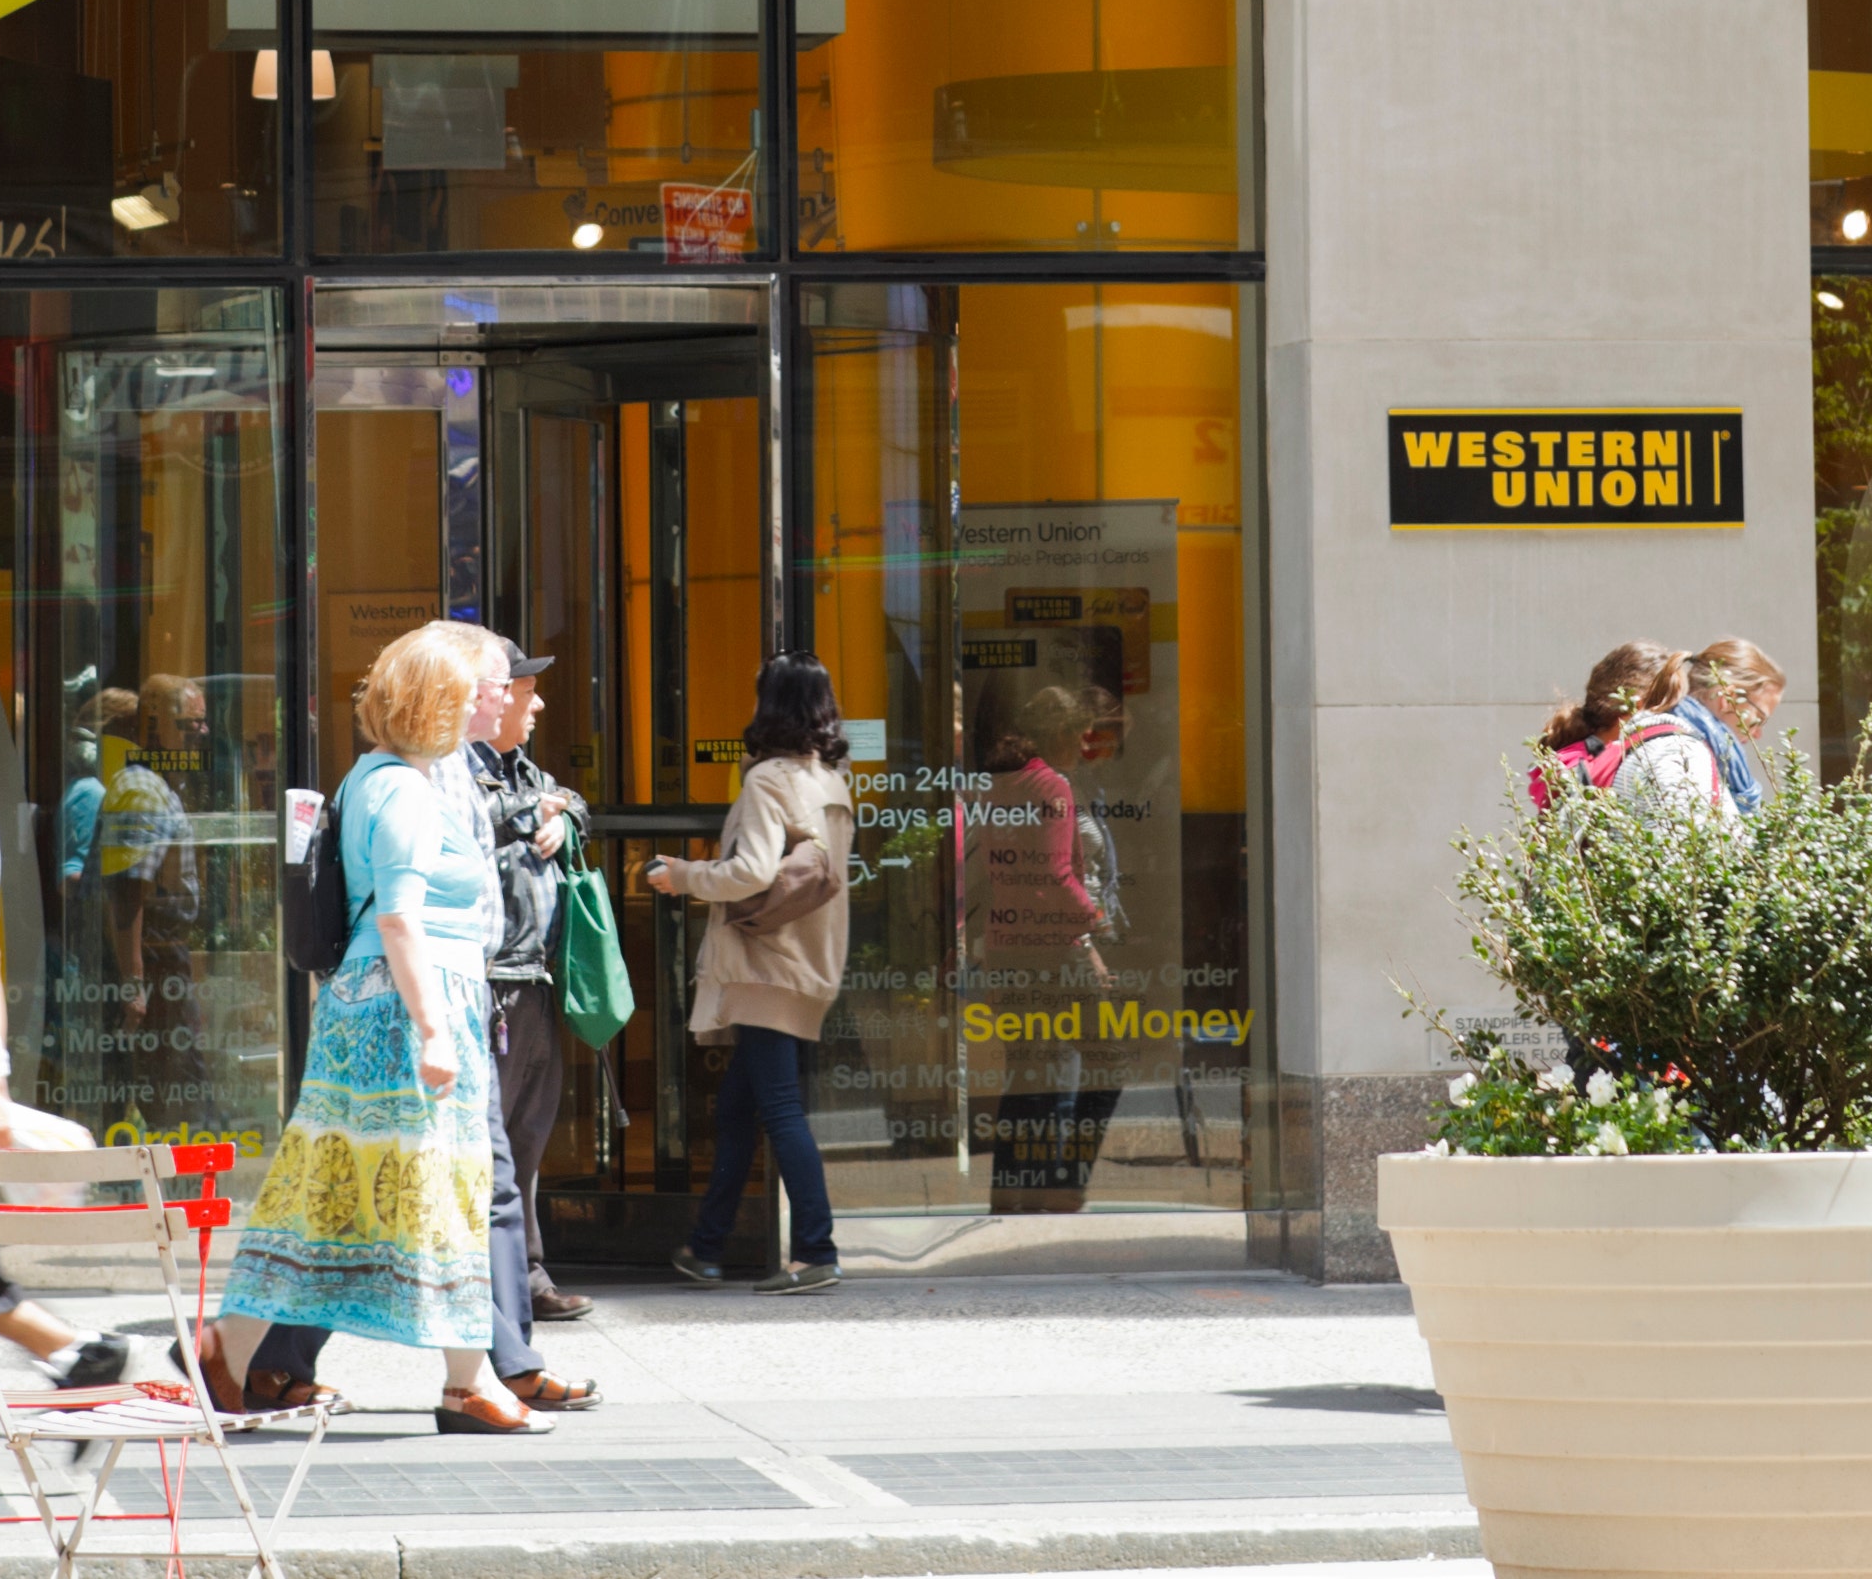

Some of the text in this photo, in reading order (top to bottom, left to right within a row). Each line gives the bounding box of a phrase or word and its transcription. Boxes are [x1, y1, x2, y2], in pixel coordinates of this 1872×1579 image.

[1403, 430, 1678, 467] WESTERN
[1492, 470, 1679, 507] UNION
[1037, 521, 1102, 543] Union
[1035, 549, 1098, 569] Prepaid
[1102, 547, 1151, 566] Cards
[349, 602, 426, 620] Western
[128, 751, 200, 761] WESTERN
[150, 761, 200, 771] UNION
[712, 751, 742, 762] UNIO
[915, 766, 993, 792] 24hrs
[857, 804, 932, 831] Days
[937, 809, 954, 828] a
[962, 800, 1042, 827] Week
[1090, 799, 1152, 820] today!
[989, 849, 1017, 864] NO
[990, 909, 1017, 924] NO
[1159, 962, 1239, 989] Order
[55, 977, 154, 1006] Money
[963, 1001, 1082, 1043] Send
[1098, 1000, 1256, 1047] Money
[68, 1025, 262, 1054] Metro Cards
[832, 1063, 908, 1090] Send
[917, 1063, 1017, 1096] Money
[35, 1080, 155, 1105] Пошлите
